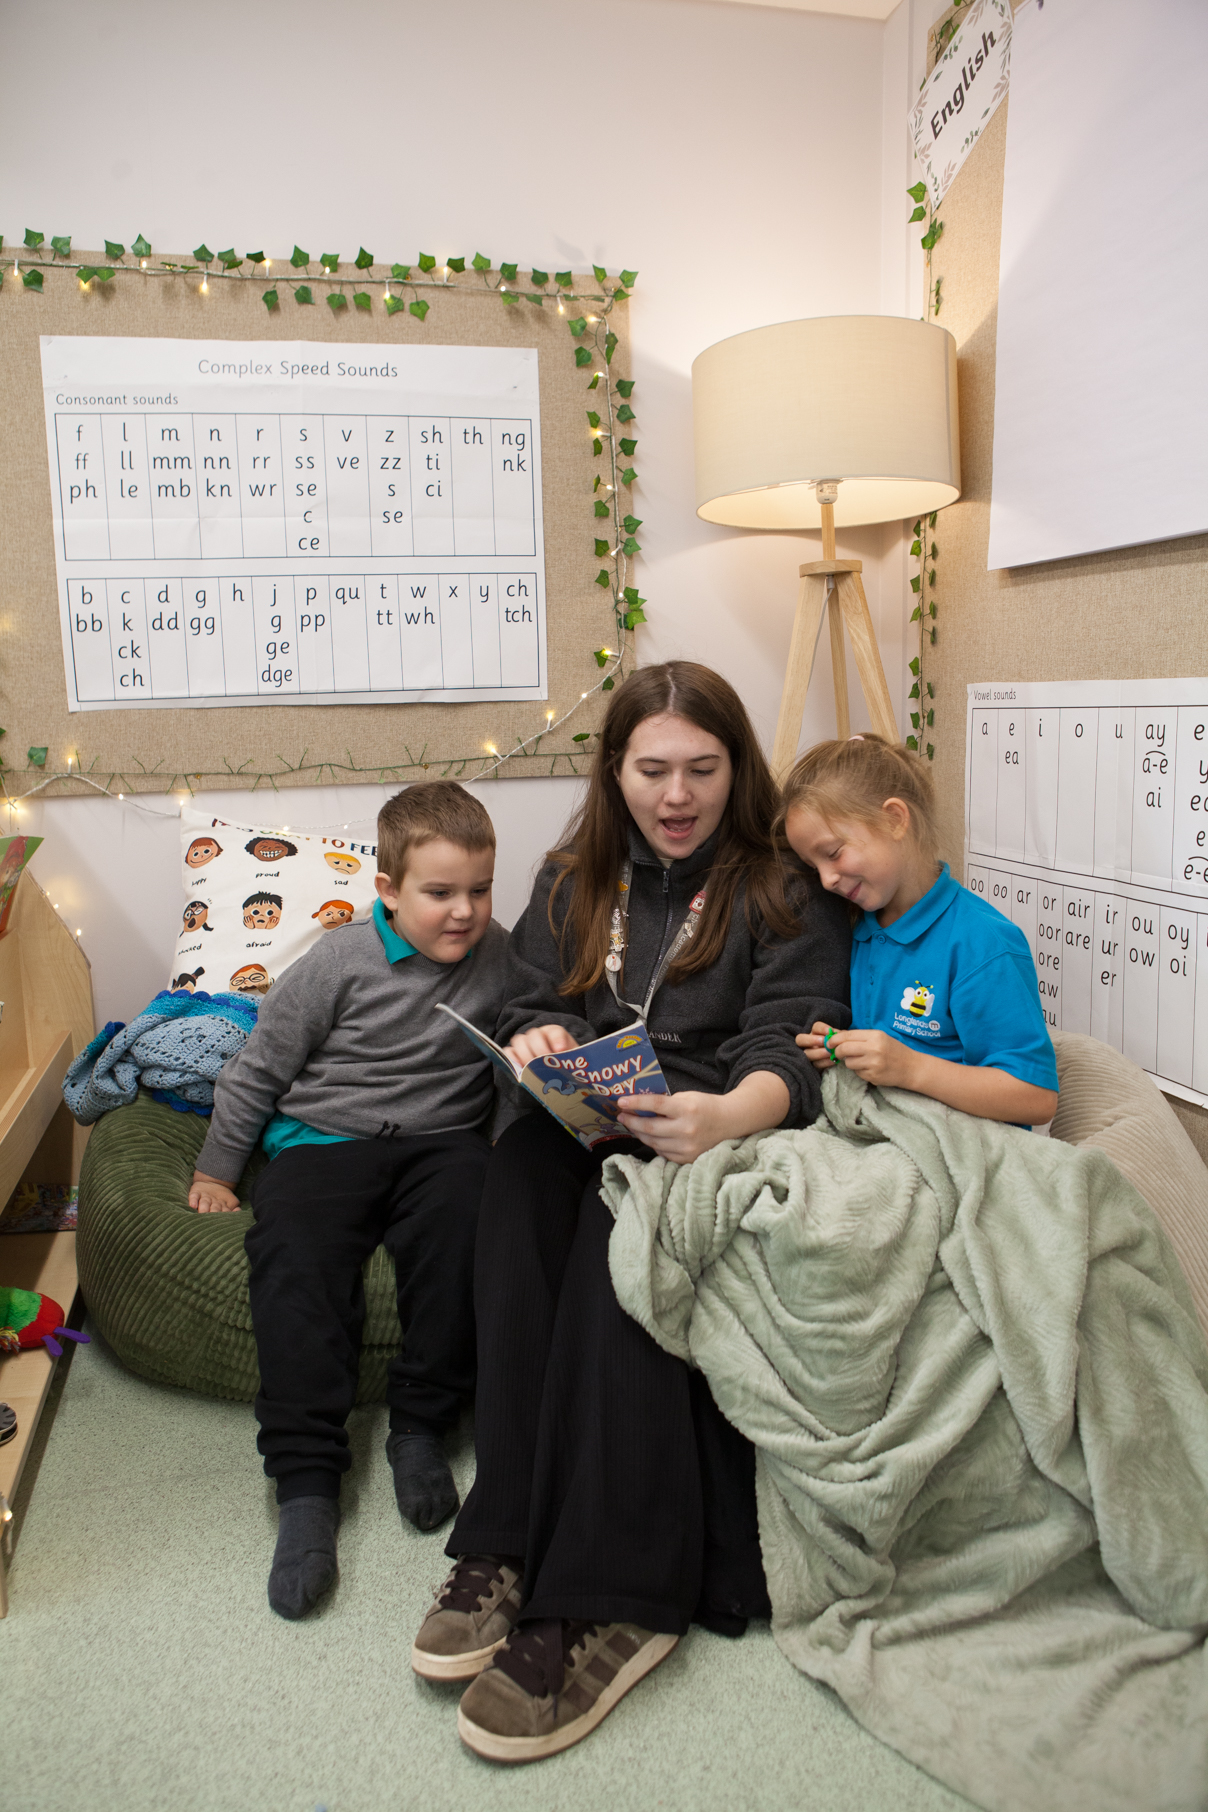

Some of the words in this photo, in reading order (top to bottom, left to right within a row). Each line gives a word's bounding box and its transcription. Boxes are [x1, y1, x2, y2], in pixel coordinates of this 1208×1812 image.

[931, 31, 996, 140] English
[199, 360, 272, 378] Complex
[281, 361, 330, 379] Speed
[338, 362, 397, 377] Sounds
[56, 394, 127, 405] Consonant
[133, 393, 178, 405] sounds
[76, 424, 83, 442] f
[123, 422, 128, 442] l
[161, 428, 180, 441] m
[210, 428, 222, 442] n
[257, 429, 264, 441] r
[300, 429, 307, 441] s
[342, 430, 352, 442] v
[385, 430, 394, 442] z
[421, 425, 443, 444] sh
[463, 426, 483, 445] th
[502, 433, 525, 451] ng
[75, 453, 89, 470] ff
[121, 450, 134, 470] ll
[153, 456, 192, 470] mm
[204, 456, 231, 469] nn
[253, 456, 270, 469] rr
[295, 456, 314, 469] ss
[337, 457, 359, 469] ve
[380, 457, 401, 470] zz
[426, 453, 440, 470] ti
[503, 453, 526, 472] nk
[70, 479, 98, 504] ph
[121, 479, 138, 498] le
[158, 478, 190, 497] mb
[206, 478, 232, 497] kn
[249, 484, 277, 497] wr
[296, 483, 317, 496] se
[388, 484, 395, 497] s
[426, 480, 442, 497] ci
[303, 511, 312, 523] c
[383, 511, 403, 523] se
[298, 537, 319, 550] ce
[82, 585, 93, 605] b
[121, 591, 130, 604] c
[158, 584, 170, 603] d
[195, 590, 206, 609] g
[233, 583, 245, 602] h
[270, 584, 276, 607] j
[306, 587, 317, 606] p
[335, 587, 360, 605] qu
[380, 583, 387, 599] t
[411, 586, 426, 598] w
[449, 586, 458, 598] x
[480, 585, 489, 603] y
[507, 579, 529, 597] ch
[76, 613, 102, 633] bb
[123, 612, 133, 631] k
[152, 611, 180, 631] dd
[190, 617, 215, 636] gg
[271, 615, 281, 633] g
[301, 614, 325, 633] pp
[376, 610, 393, 625] tt
[405, 606, 435, 625] wh
[505, 605, 532, 623] tch
[118, 639, 142, 659] ck
[266, 642, 290, 660] ge
[120, 668, 145, 687] ch
[262, 664, 292, 687] dge
[973, 689, 992, 701] Vowel
[993, 688, 1017, 701] sounds
[982, 722, 988, 735] a
[1009, 723, 1014, 736] e
[1039, 718, 1042, 737] i
[1075, 723, 1083, 738] o
[1115, 724, 1123, 739] u
[1146, 724, 1165, 747] ay
[1005, 751, 1019, 764] ea
[1146, 787, 1161, 808] ai
[1196, 831, 1205, 847] e
[350, 842, 378, 857] FEE
[972, 879, 984, 892] oo
[993, 884, 1007, 898] oo
[1017, 890, 1031, 904] ar
[1043, 896, 1056, 911] or
[1068, 899, 1090, 918] air
[1106, 904, 1118, 924] ir
[1132, 916, 1153, 935] ou
[1168, 924, 1189, 950] oy
[245, 940, 272, 948] afraid
[1039, 923, 1061, 941] oor
[1066, 931, 1090, 949] are
[1102, 940, 1118, 956] ur
[1130, 948, 1155, 967] ow
[1170, 955, 1187, 977] oi
[1039, 952, 1059, 970] ore
[1101, 971, 1116, 987] er
[1039, 981, 1058, 998] aw
[893, 1021, 916, 1035] Primary
[917, 1028, 941, 1037] School
[894, 1012, 929, 1028] Longlands
[647, 1031, 682, 1043] ANDER
[543, 1055, 589, 1070] One
[572, 1055, 643, 1084] Snowy
[592, 1078, 636, 1096] Day
